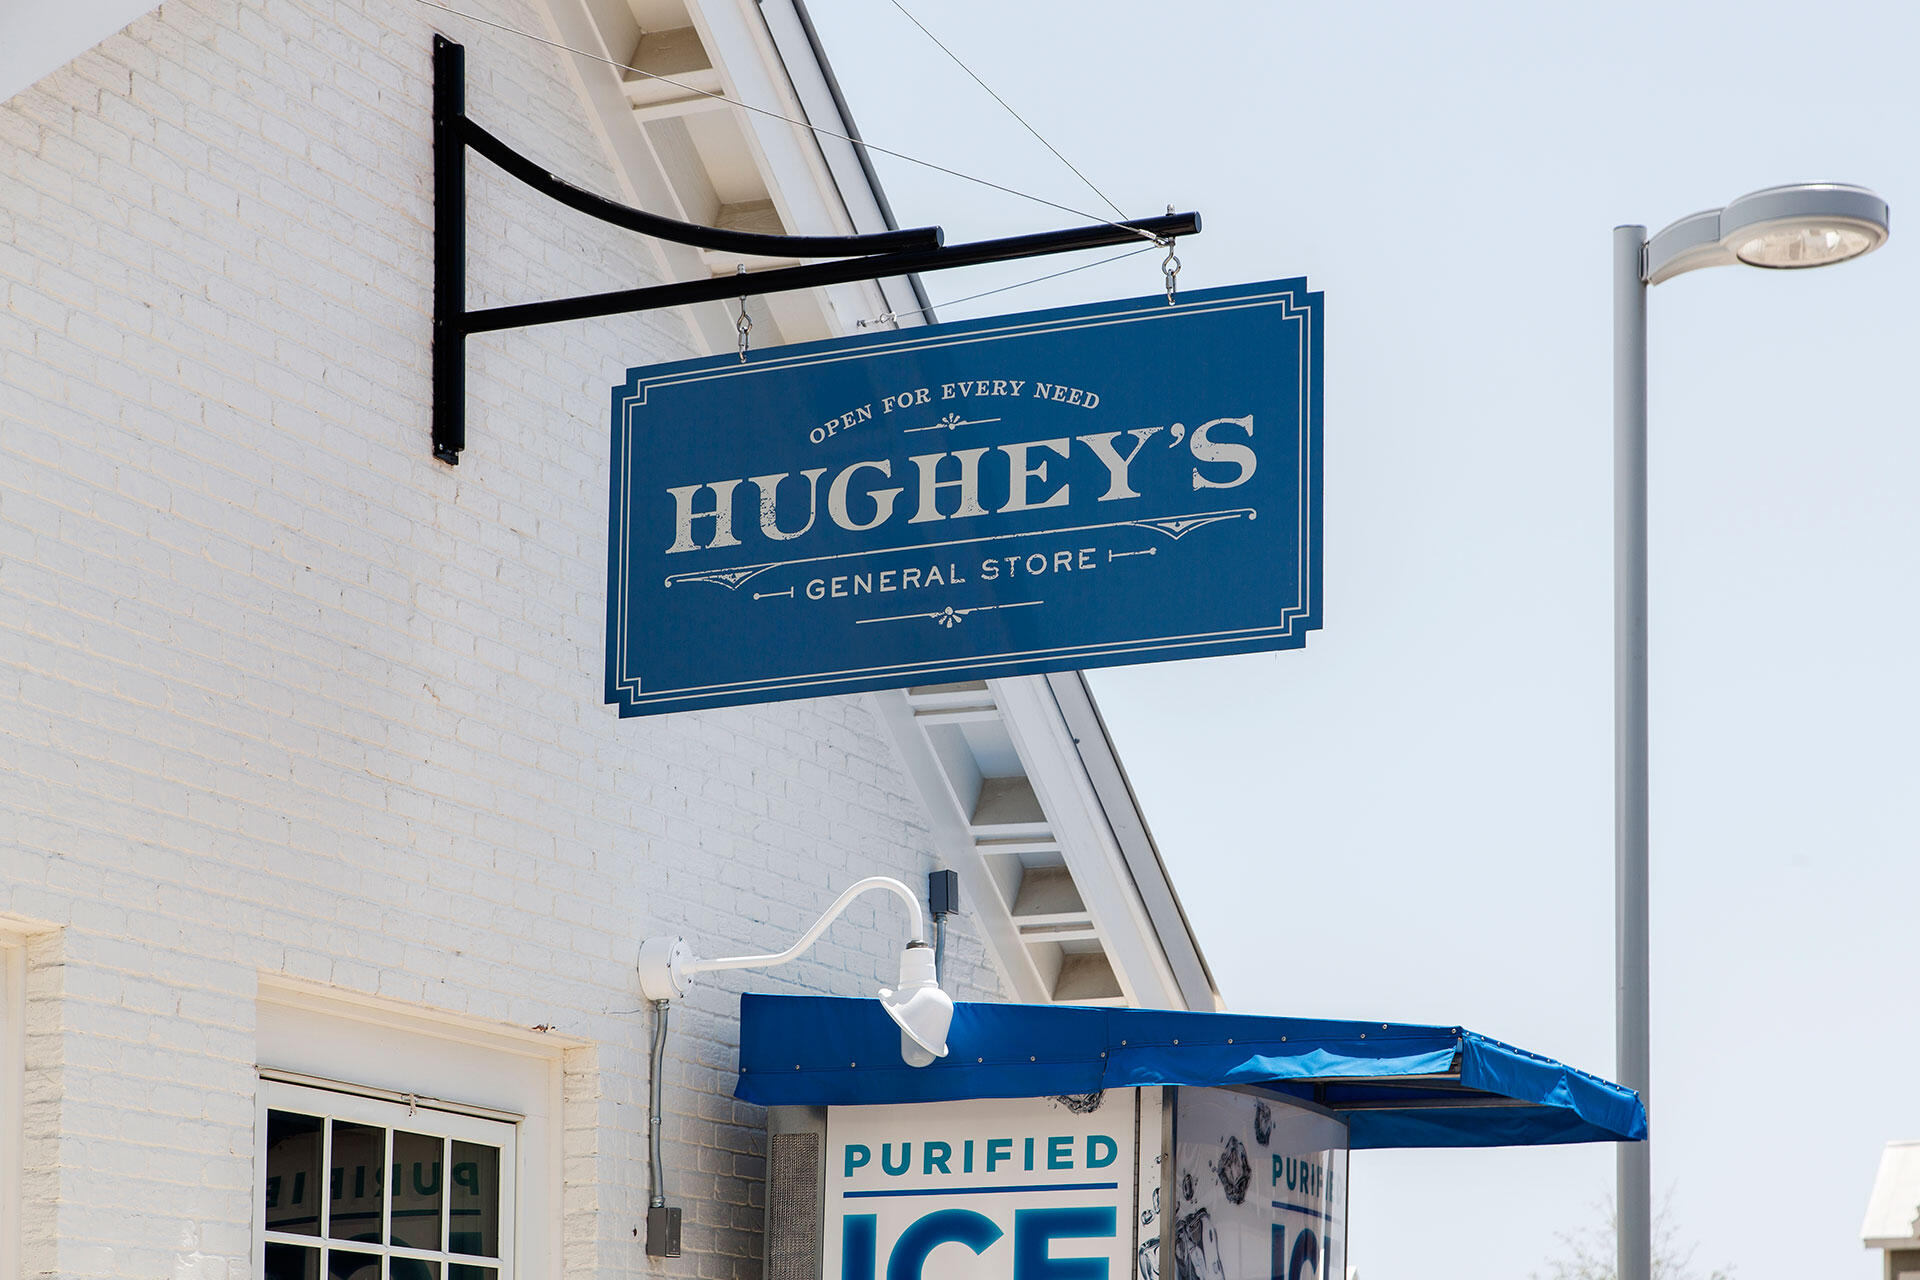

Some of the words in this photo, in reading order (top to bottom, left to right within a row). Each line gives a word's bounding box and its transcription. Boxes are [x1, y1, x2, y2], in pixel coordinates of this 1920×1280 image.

[809, 403, 872, 444] OPEN
[881, 388, 932, 414] FOR
[941, 380, 1026, 400] EVERY
[1033, 382, 1100, 409] NEED
[665, 414, 1257, 554] HUGHEY'S
[806, 563, 966, 600] GENERAL
[980, 547, 1097, 581] STORE
[844, 1134, 1118, 1178] PURIFIED
